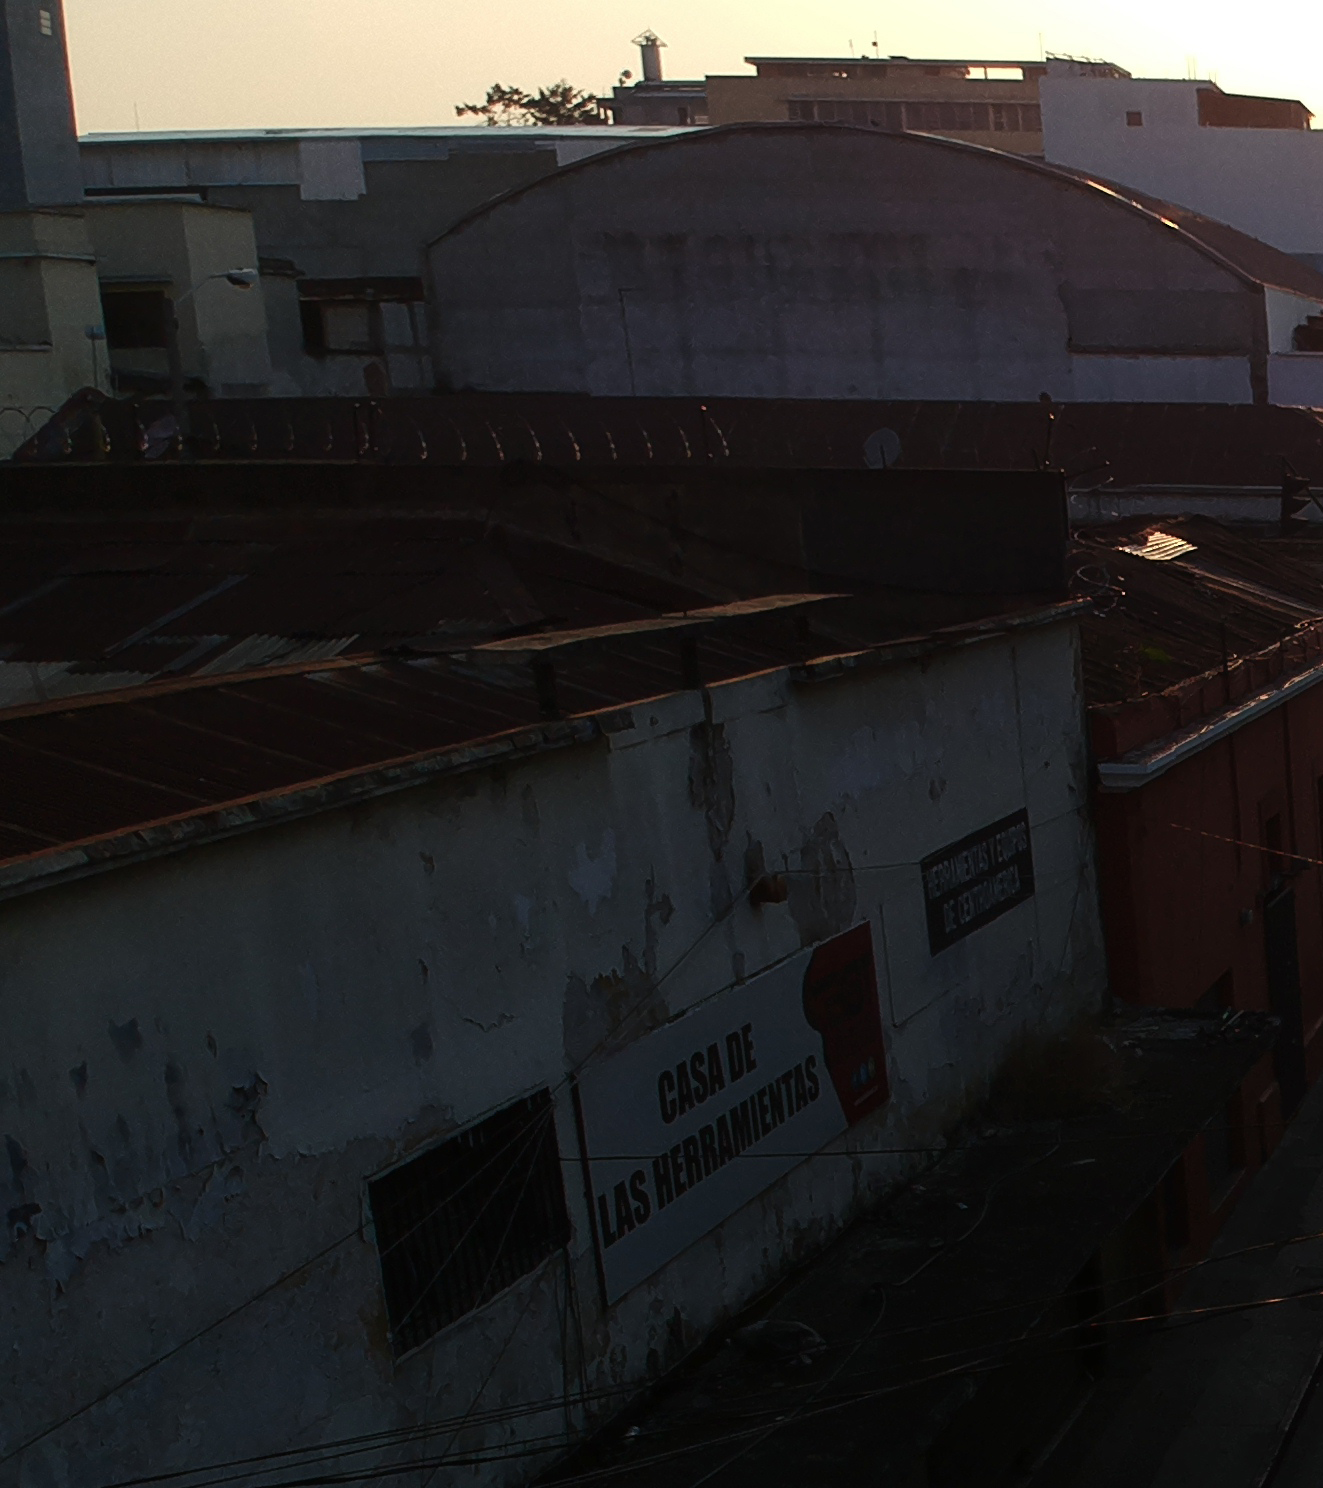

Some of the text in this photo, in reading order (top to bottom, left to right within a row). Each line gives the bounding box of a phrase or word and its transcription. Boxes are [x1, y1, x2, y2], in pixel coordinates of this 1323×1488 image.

[944, 899, 957, 934] DE
[658, 1022, 757, 1124] CASA DE
[598, 1054, 820, 1249] LAS HERRAMIENTAS
